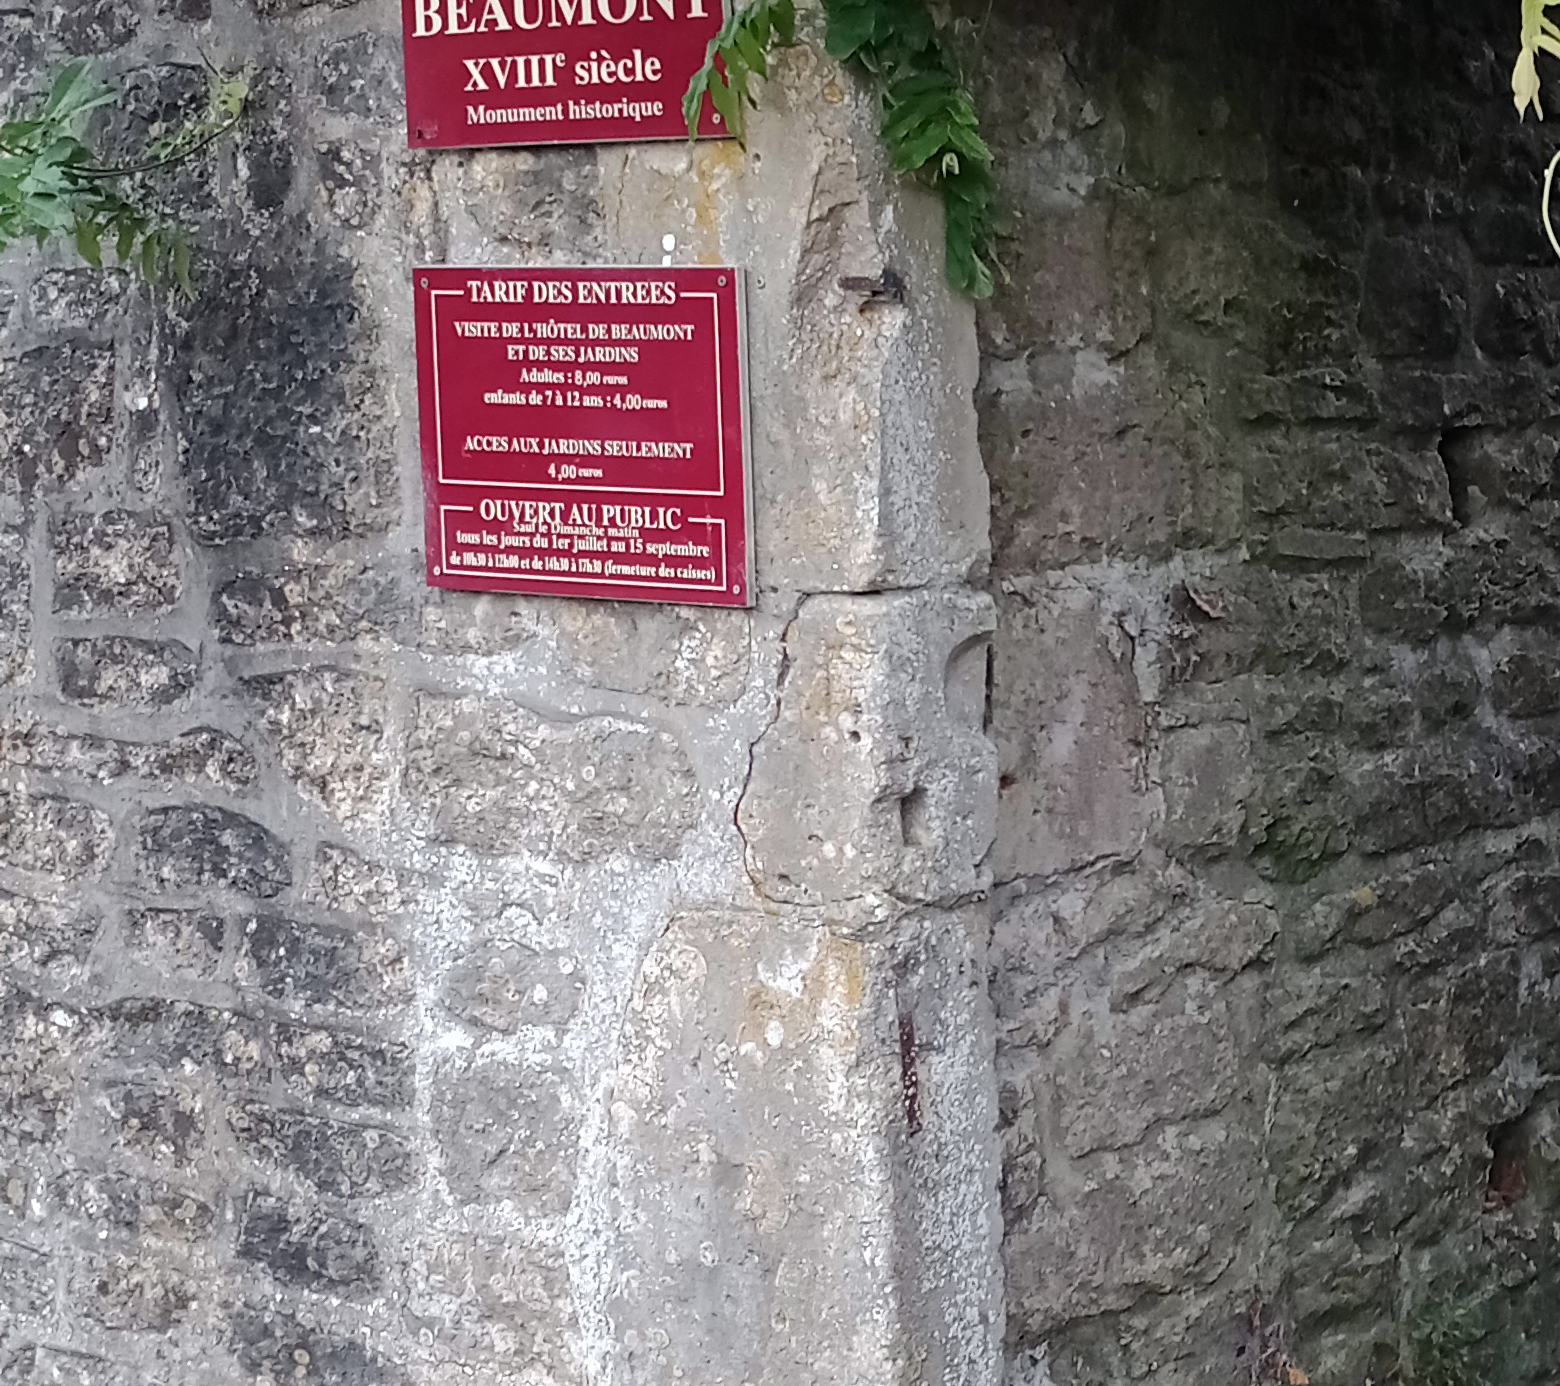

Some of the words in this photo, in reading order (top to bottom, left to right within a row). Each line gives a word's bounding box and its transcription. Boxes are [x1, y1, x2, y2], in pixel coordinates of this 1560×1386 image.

[574, 48, 663, 87] siècle
[466, 102, 565, 125] Monument
[568, 97, 664, 123] historique
[467, 280, 529, 304] TARIF
[531, 281, 574, 305] DES
[577, 281, 677, 305] ENTREES
[453, 321, 500, 338] VISITE
[502, 321, 522, 338] DE
[523, 319, 586, 339] L'HÔTEL
[588, 323, 609, 340] DE
[611, 323, 695, 341] BEAUMONT
[507, 344, 526, 361] ET
[528, 345, 548, 361] DE
[550, 345, 576, 362] SES
[577, 346, 640, 363] JARDINS
[519, 368, 565, 385] Adultes
[574, 370, 601, 389] 8,00
[602, 375, 629, 386] euros
[483, 389, 527, 405] enfants
[528, 390, 544, 406] de
[544, 391, 553, 405] 7
[555, 391, 564, 406] à
[566, 392, 581, 407] 12
[582, 395, 604, 408] ans
[613, 393, 642, 412] 4,00
[642, 398, 669, 410] euros
[464, 435, 509, 452] ACCES
[510, 437, 540, 454] AUX
[541, 439, 602, 456] JARDINS
[604, 441, 694, 459] SEULEMENT
[547, 463, 577, 482] 4,00
[577, 468, 604, 479] euros
[479, 498, 566, 524] OUVERT
[568, 503, 596, 526] AU
[601, 503, 682, 531] PUBLIC
[512, 521, 536, 534] Sauf
[537, 522, 548, 535] le
[550, 522, 606, 538] Dimanche
[607, 525, 640, 539] matin
[456, 529, 481, 545] tous
[482, 530, 498, 546] les
[499, 531, 531, 550] jours
[532, 532, 549, 549] du
[551, 534, 570, 550] 1er
[571, 534, 609, 554] juillet
[610, 539, 626, 553] au
[628, 538, 643, 554] 15
[645, 540, 710, 559] septembre
[449, 553, 462, 566] de
[487, 555, 494, 567] à
[520, 557, 530, 570] et
[532, 557, 544, 570] de
[571, 558, 577, 572] à
[604, 561, 657, 577] (fermeture
[658, 562, 675, 578] des
[676, 565, 716, 583] caisses)
